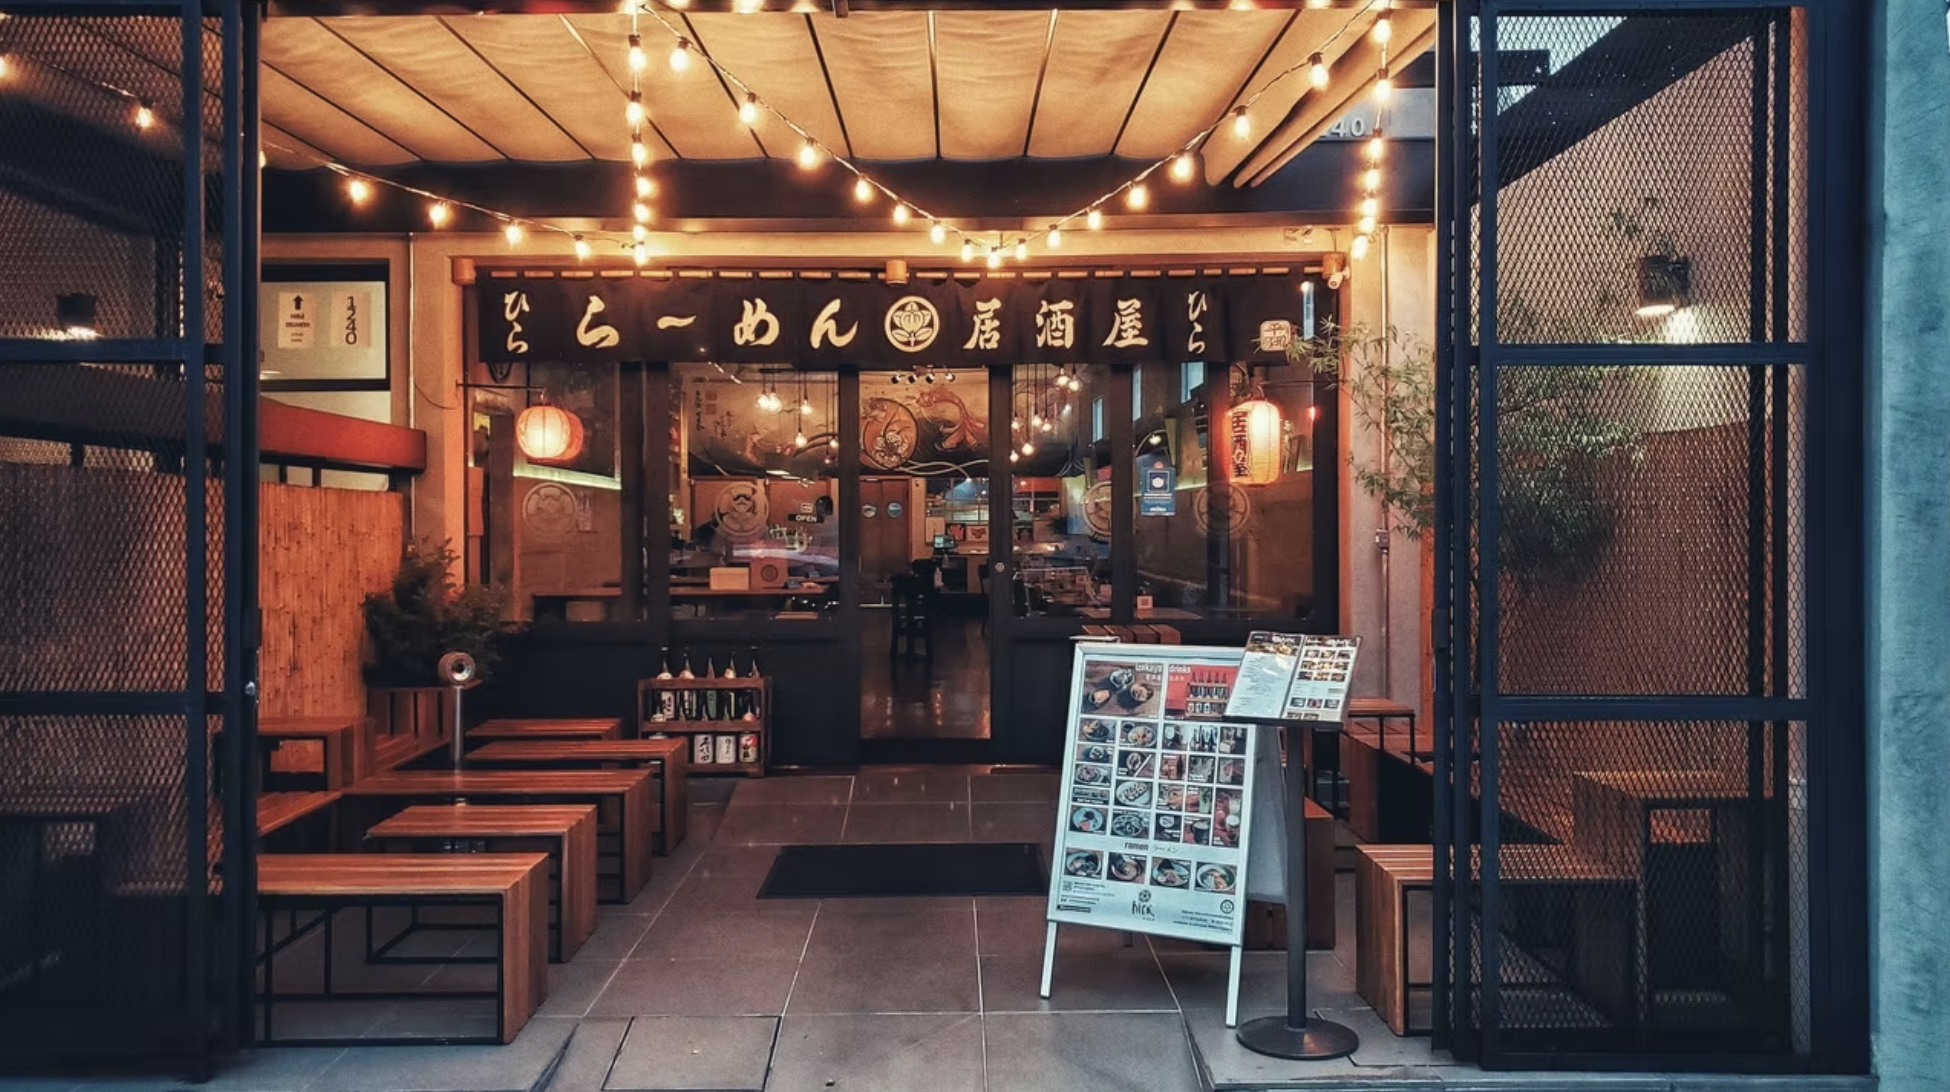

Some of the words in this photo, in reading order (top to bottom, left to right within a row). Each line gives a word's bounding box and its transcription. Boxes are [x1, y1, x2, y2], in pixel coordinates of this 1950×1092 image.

[345, 296, 358, 345] 1240
[504, 291, 530, 353] ひら
[577, 296, 858, 349] らーめん
[963, 298, 1149, 350] 居酒屋
[1187, 291, 1207, 354] ひら
[795, 514, 818, 523] OPEN
[1124, 842, 1148, 851] ramen
